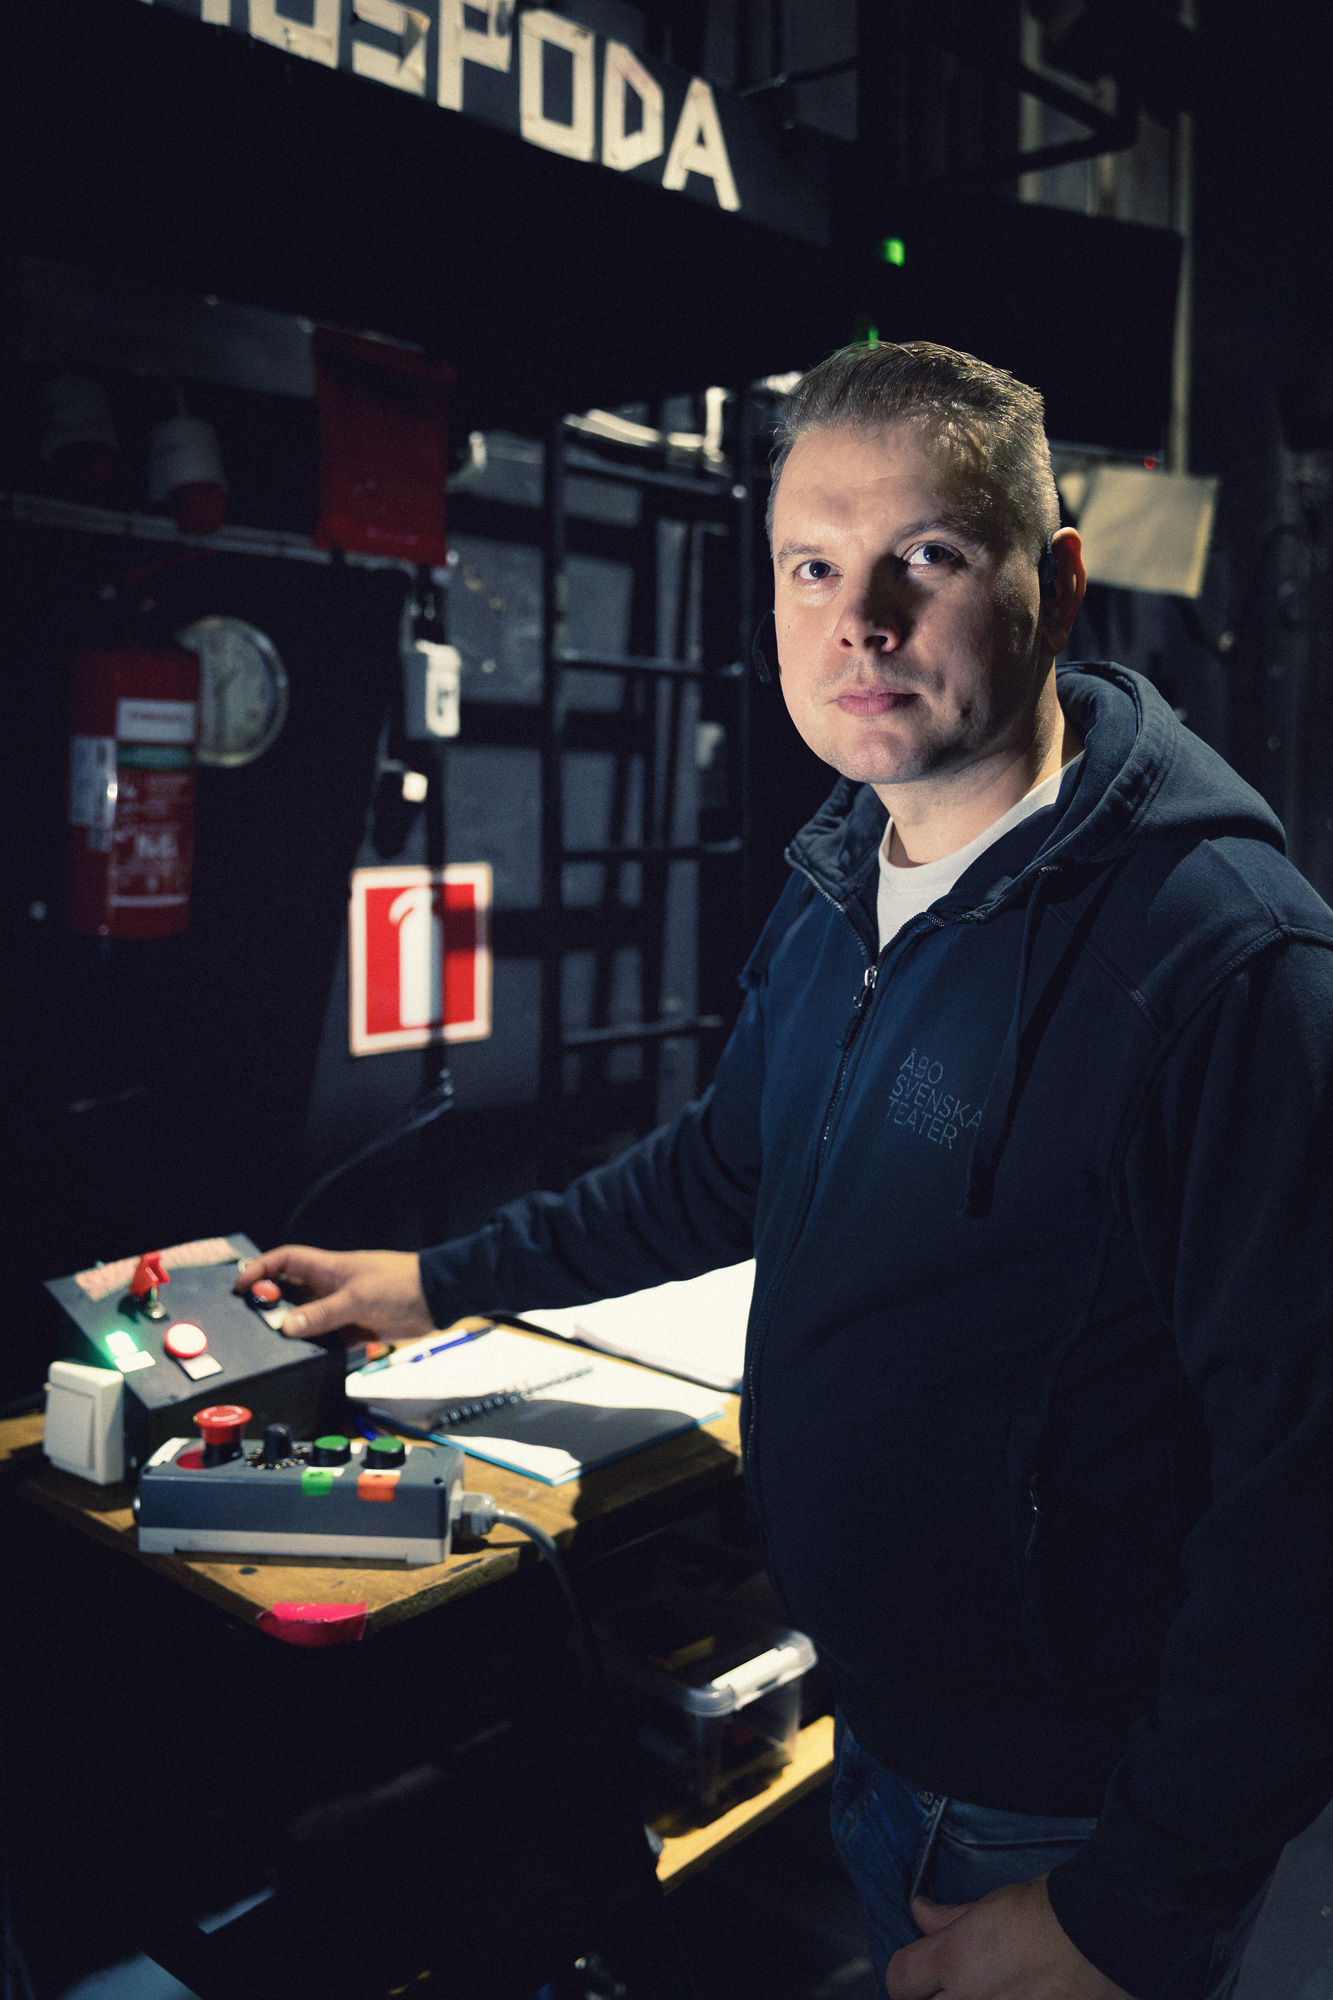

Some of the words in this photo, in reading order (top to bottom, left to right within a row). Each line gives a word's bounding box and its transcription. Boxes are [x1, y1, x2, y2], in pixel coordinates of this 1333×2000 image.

[138, 0, 741, 211] SPODA
[900, 1048, 943, 1084] ÅBO
[886, 1095, 958, 1149] TEATER
[892, 1073, 983, 1129] SVENSKA
